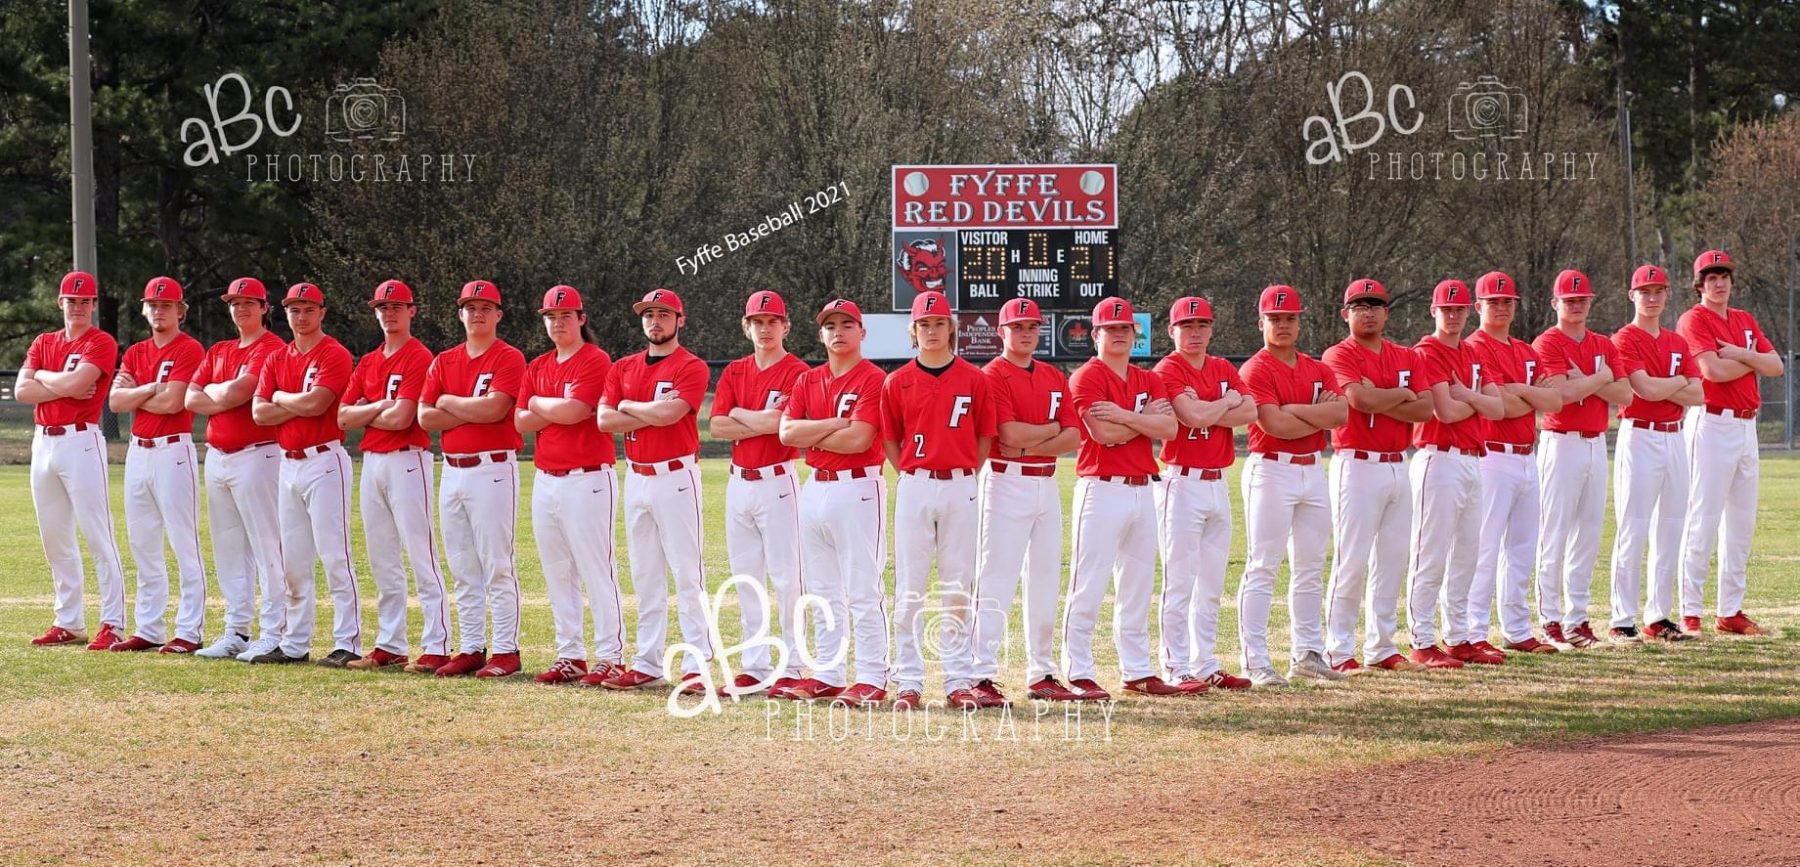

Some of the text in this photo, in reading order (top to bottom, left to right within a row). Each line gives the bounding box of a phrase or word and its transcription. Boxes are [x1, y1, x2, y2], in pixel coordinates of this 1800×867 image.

[949, 169, 1060, 196] FYFFE
[904, 197, 1106, 224] RED DEVILS
[961, 231, 1008, 245] VISITOR
[1075, 231, 1109, 244] HOME
[1011, 249, 1020, 263] H
[1057, 249, 1065, 263] E
[1071, 246, 1114, 280] 21
[1713, 254, 1722, 264] F
[963, 247, 1006, 280] 20
[1018, 269, 1058, 282] INNING
[1648, 269, 1657, 281] F
[74, 279, 84, 293] F
[155, 283, 166, 297] F
[236, 281, 248, 295] F
[298, 285, 309, 298] F
[473, 284, 485, 297] F
[970, 284, 999, 298] BALL
[1017, 283, 1060, 297] STRIKE
[1080, 283, 1104, 297] OUT
[1364, 283, 1373, 293] F
[1497, 278, 1506, 292] F
[1572, 277, 1581, 292] F
[384, 285, 395, 299] F
[554, 291, 566, 306] F
[652, 291, 664, 303] F
[1448, 287, 1459, 301] F
[760, 295, 771, 309] F
[834, 300, 846, 309] F
[925, 297, 937, 312] F
[1275, 293, 1287, 308] F
[1019, 301, 1029, 315] F
[1113, 303, 1123, 318] F
[1189, 301, 1199, 315] F
[971, 336, 992, 344] BANK
[1670, 353, 1682, 376] F
[156, 361, 174, 383] F
[1472, 364, 1480, 391] F
[1525, 361, 1535, 386] F
[386, 374, 402, 400] F
[473, 374, 493, 397] F
[837, 394, 858, 420] F
[950, 396, 972, 428] F
[1048, 392, 1062, 422] F
[913, 433, 925, 458] 2
